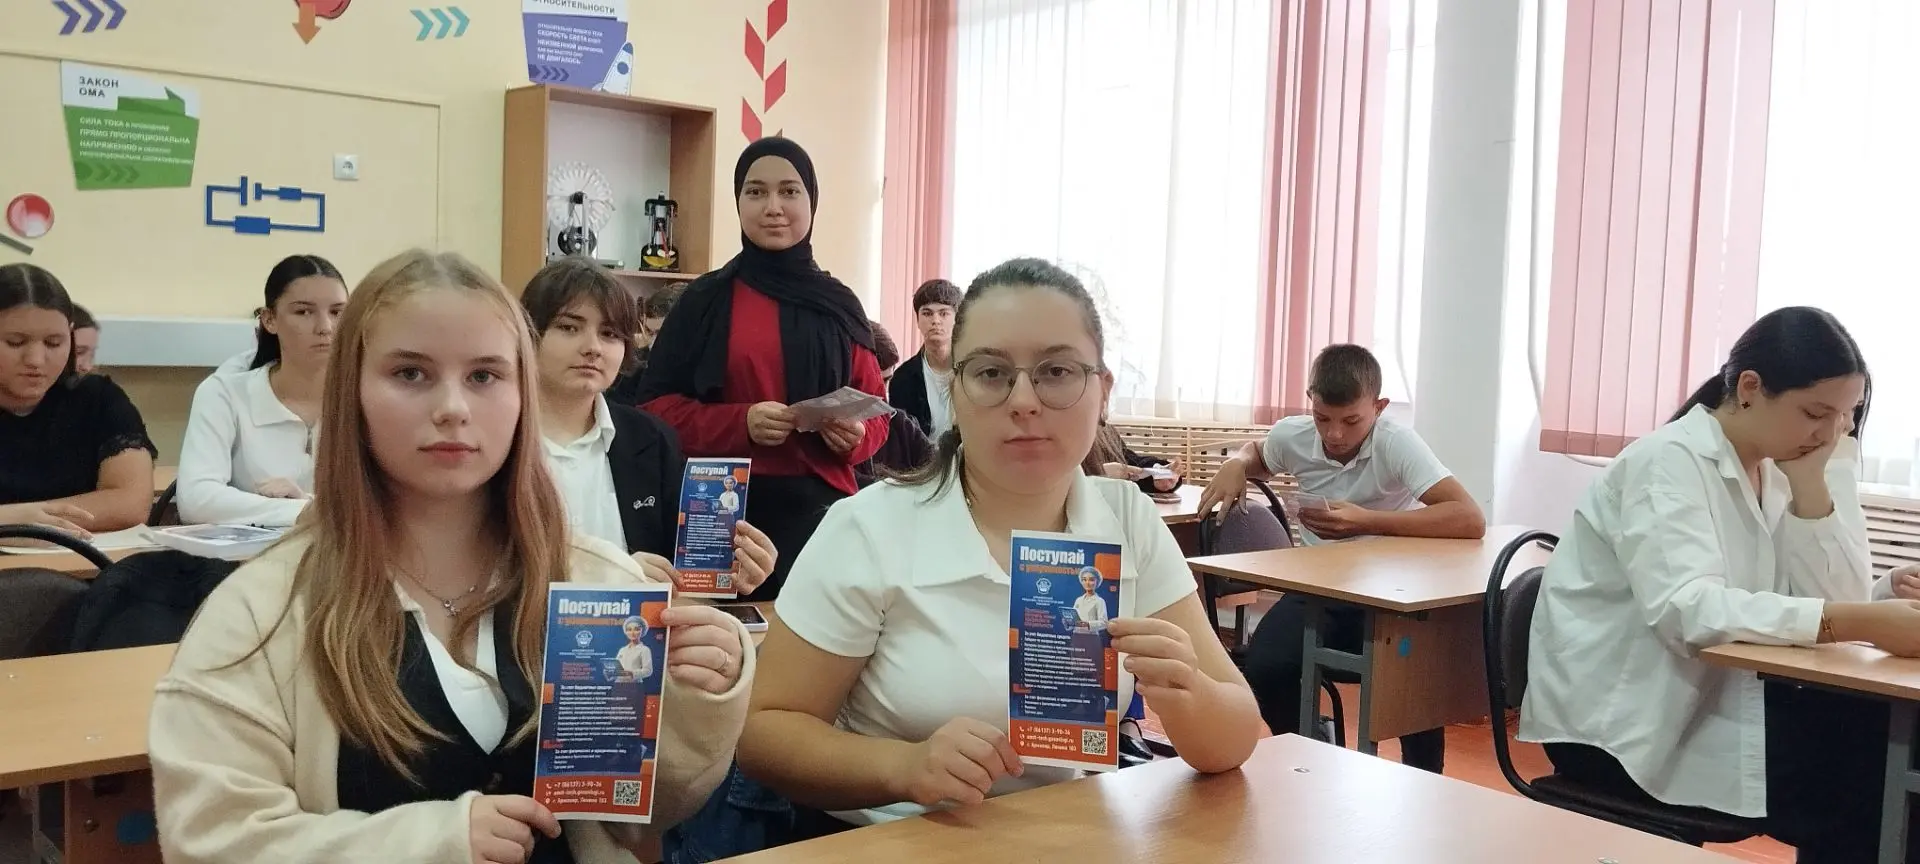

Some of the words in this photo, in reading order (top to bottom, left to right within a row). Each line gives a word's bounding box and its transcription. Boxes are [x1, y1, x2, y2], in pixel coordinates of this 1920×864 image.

[533, 0, 614, 13] ТНОСИТЕЛЬНОСТИ
[538, 30, 568, 39] СКОРОСТЬ
[569, 34, 587, 42] СВЕТА
[80, 76, 119, 88] ЗАКОН
[79, 87, 105, 97] ОМА
[80, 117, 102, 125] СИЛА
[105, 119, 124, 127] ТОКА
[80, 128, 108, 138] ПРЯМО
[110, 130, 190, 144] ПРОПОРЦИОНАЛЬНА
[80, 140, 137, 151] НАПРЯЖЕНИЮ
[690, 466, 728, 476] Поступай
[1020, 546, 1085, 565] Поступай
[558, 598, 631, 617] Поступай
